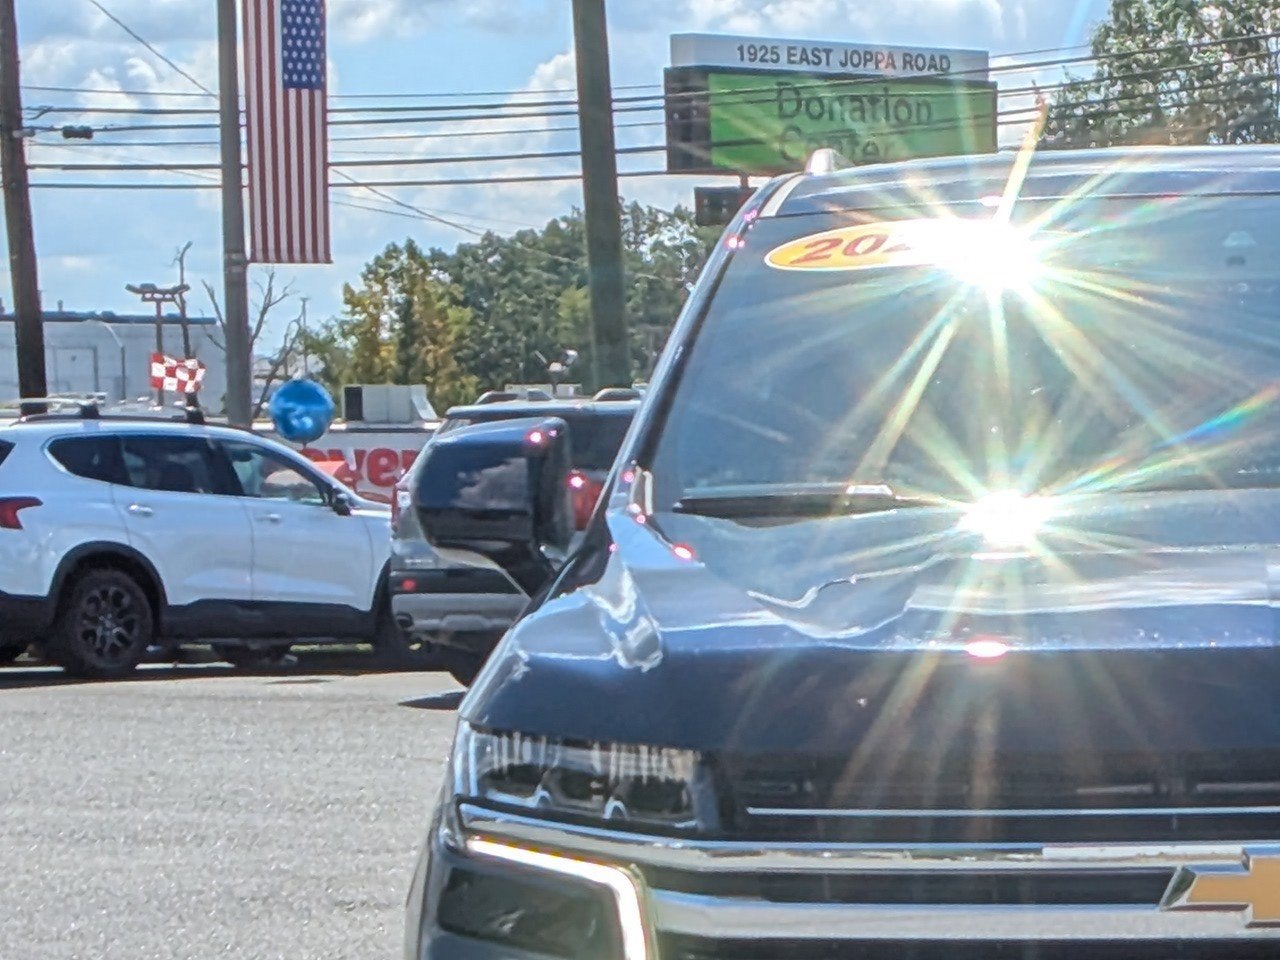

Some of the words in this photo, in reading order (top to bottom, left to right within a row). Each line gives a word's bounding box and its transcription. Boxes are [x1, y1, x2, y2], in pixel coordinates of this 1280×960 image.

[737, 44, 780, 64] 1925
[787, 46, 833, 67] EAST
[839, 48, 897, 70] JOPPA
[902, 52, 951, 73] ROAD
[777, 81, 933, 126] Donation
